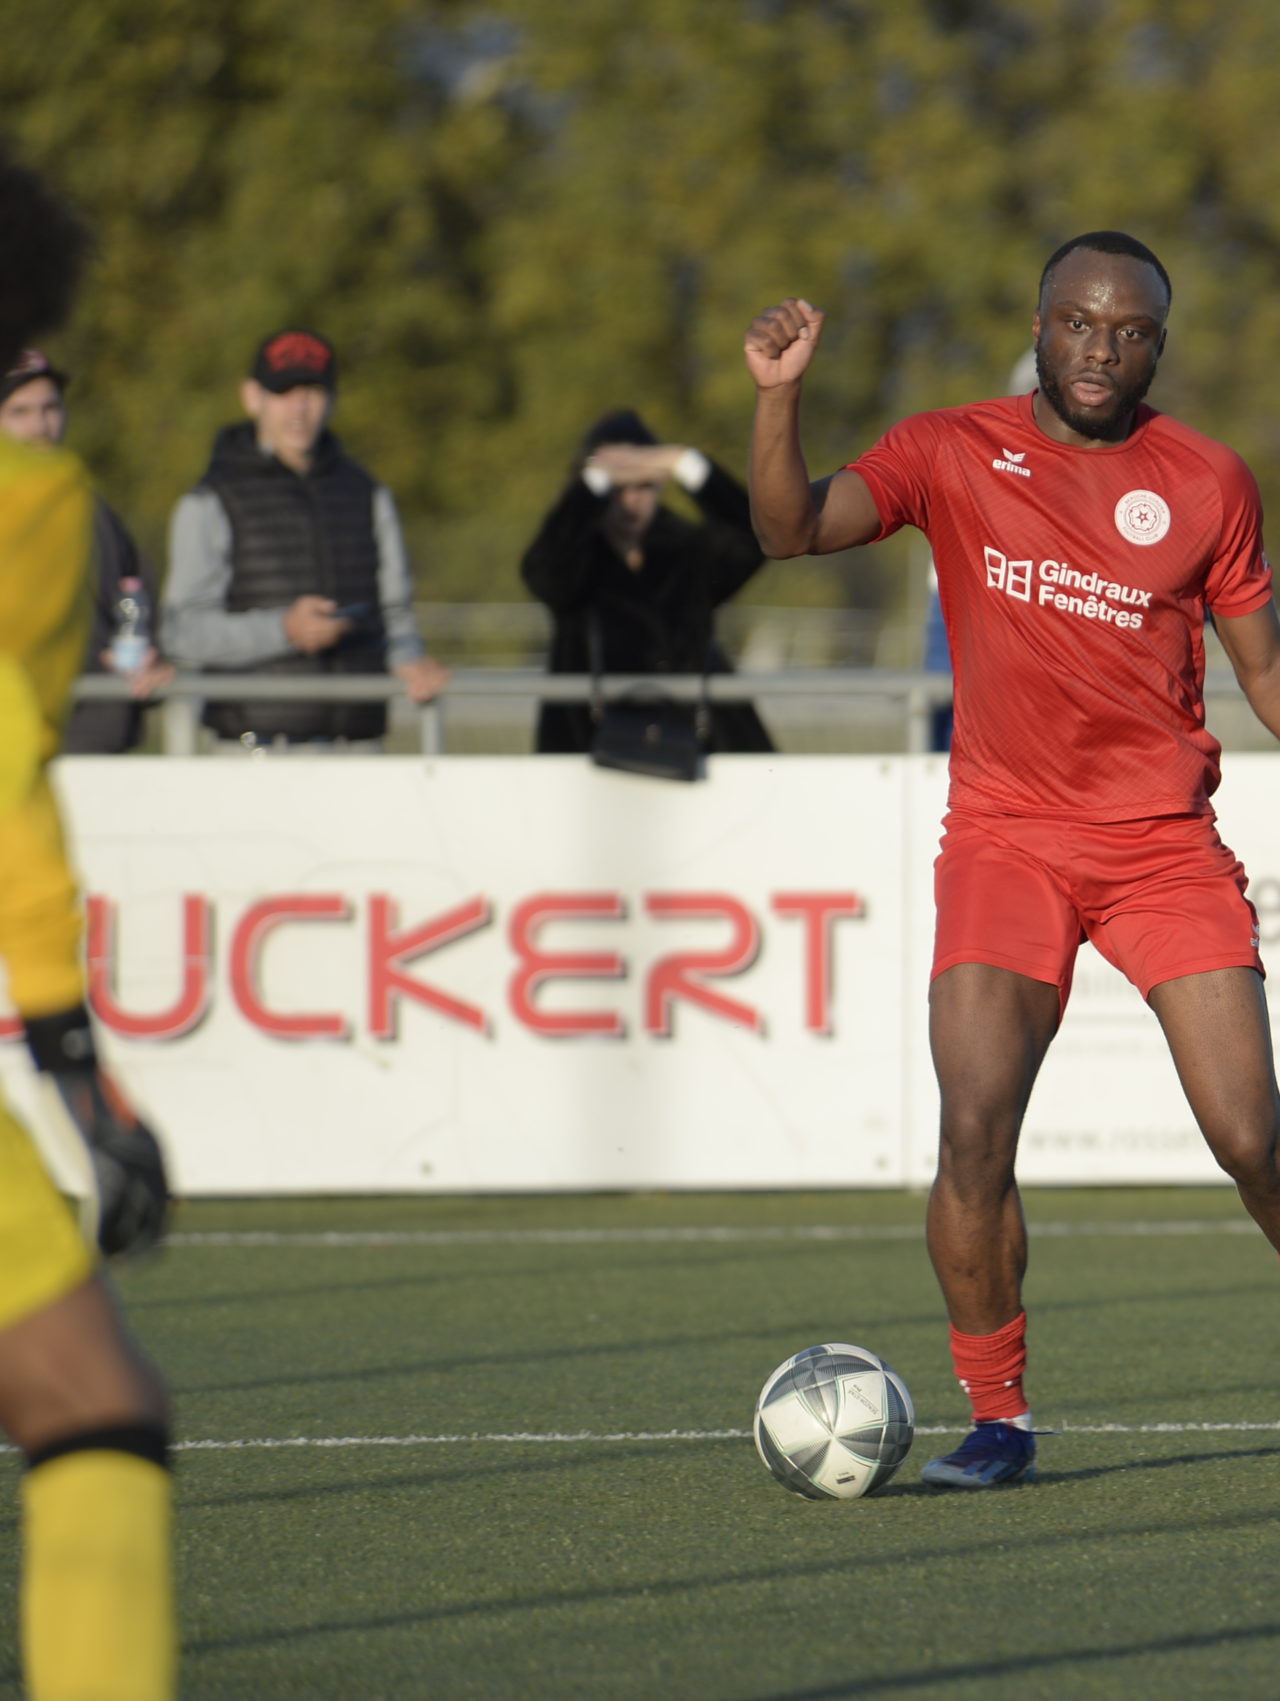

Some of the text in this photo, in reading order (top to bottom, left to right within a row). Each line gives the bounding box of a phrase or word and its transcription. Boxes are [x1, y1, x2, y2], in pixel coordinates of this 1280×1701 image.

[992, 458, 1031, 478] erima
[1038, 559, 1153, 608] Gindraux
[1038, 584, 1144, 629] Fenêtres
[0, 891, 866, 1042] UCKERT
